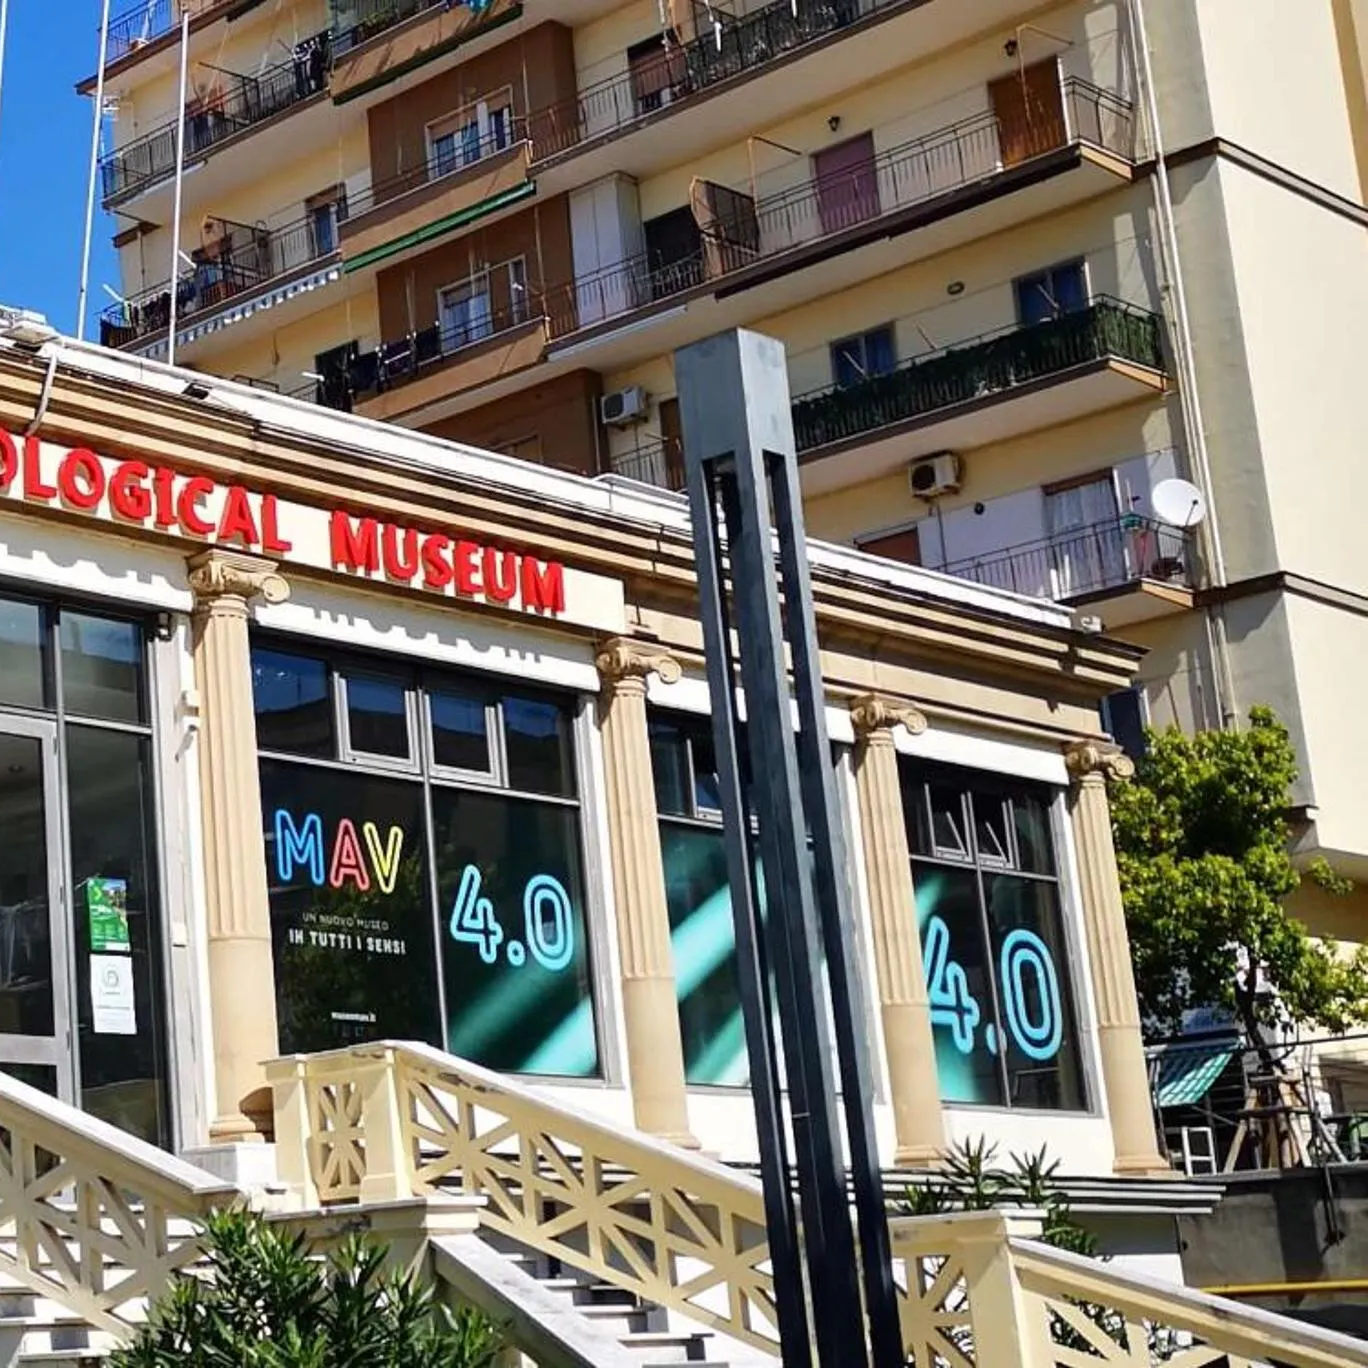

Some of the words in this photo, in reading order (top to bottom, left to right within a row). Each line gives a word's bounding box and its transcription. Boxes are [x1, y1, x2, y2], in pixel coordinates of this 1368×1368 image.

[330, 509, 567, 615] MUSEUM
[275, 809, 403, 894] MAV
[289, 928, 304, 945] IN
[309, 931, 352, 949] TUTTI
[366, 936, 406, 955] SENSI
[450, 865, 573, 970] 4.0
[922, 916, 1063, 1061] 4.0
